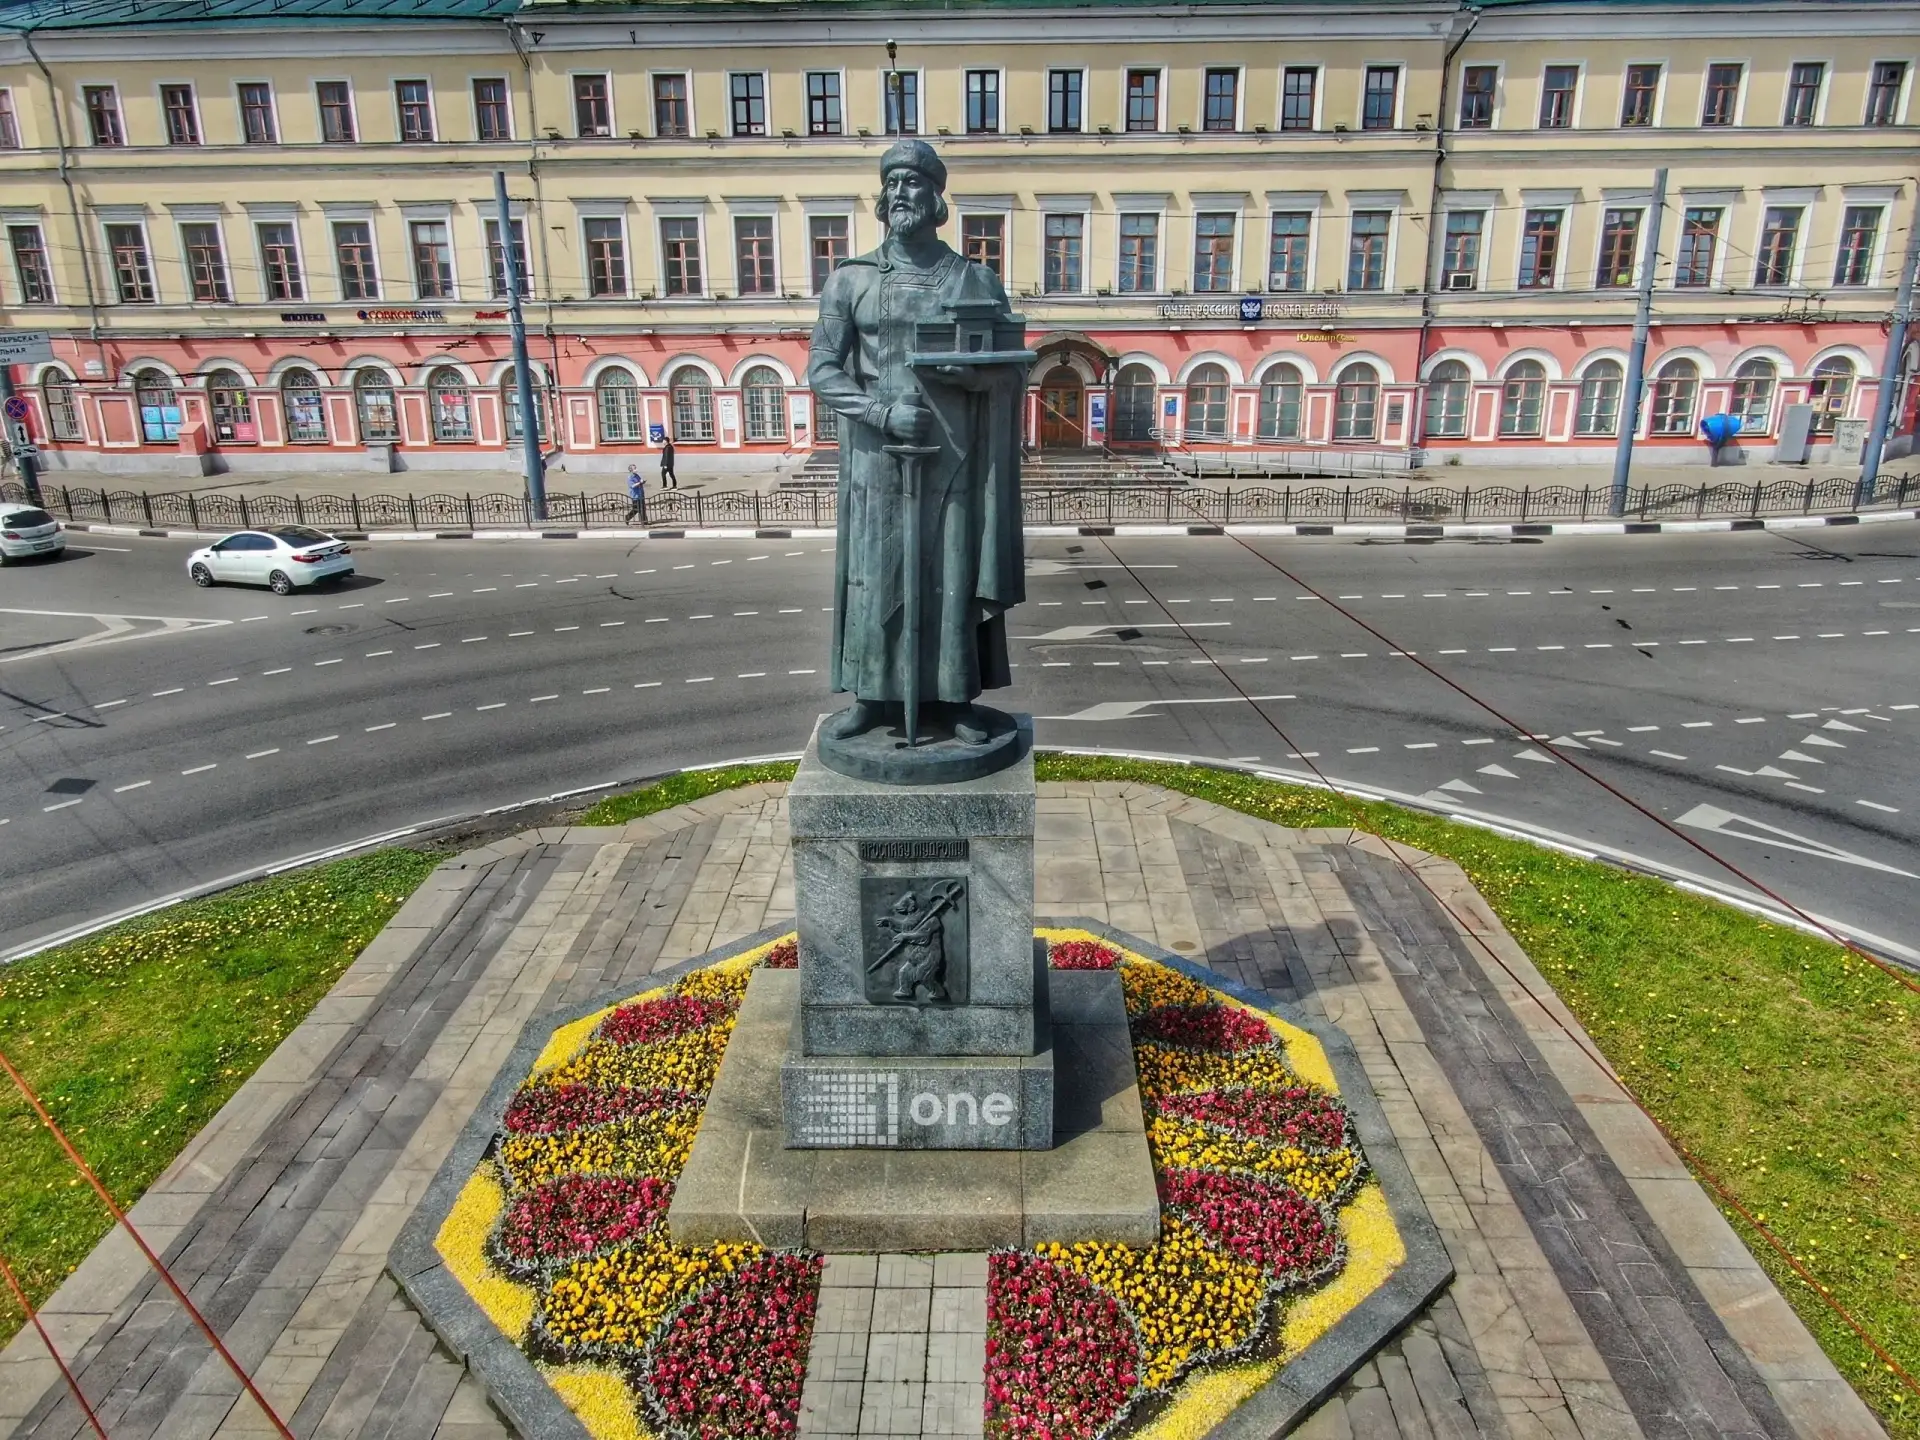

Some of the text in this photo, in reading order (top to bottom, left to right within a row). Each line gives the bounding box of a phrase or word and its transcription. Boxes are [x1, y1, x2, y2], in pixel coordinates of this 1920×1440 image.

[368, 310, 443, 320] СОВКОМБАНК
[1156, 304, 1236, 316] ПОЧТА РОССИИ
[1265, 303, 1341, 315] ПОЧТА БАНК
[860, 840, 964, 858] ЯРОСЛАВУ МУДРОМУ
